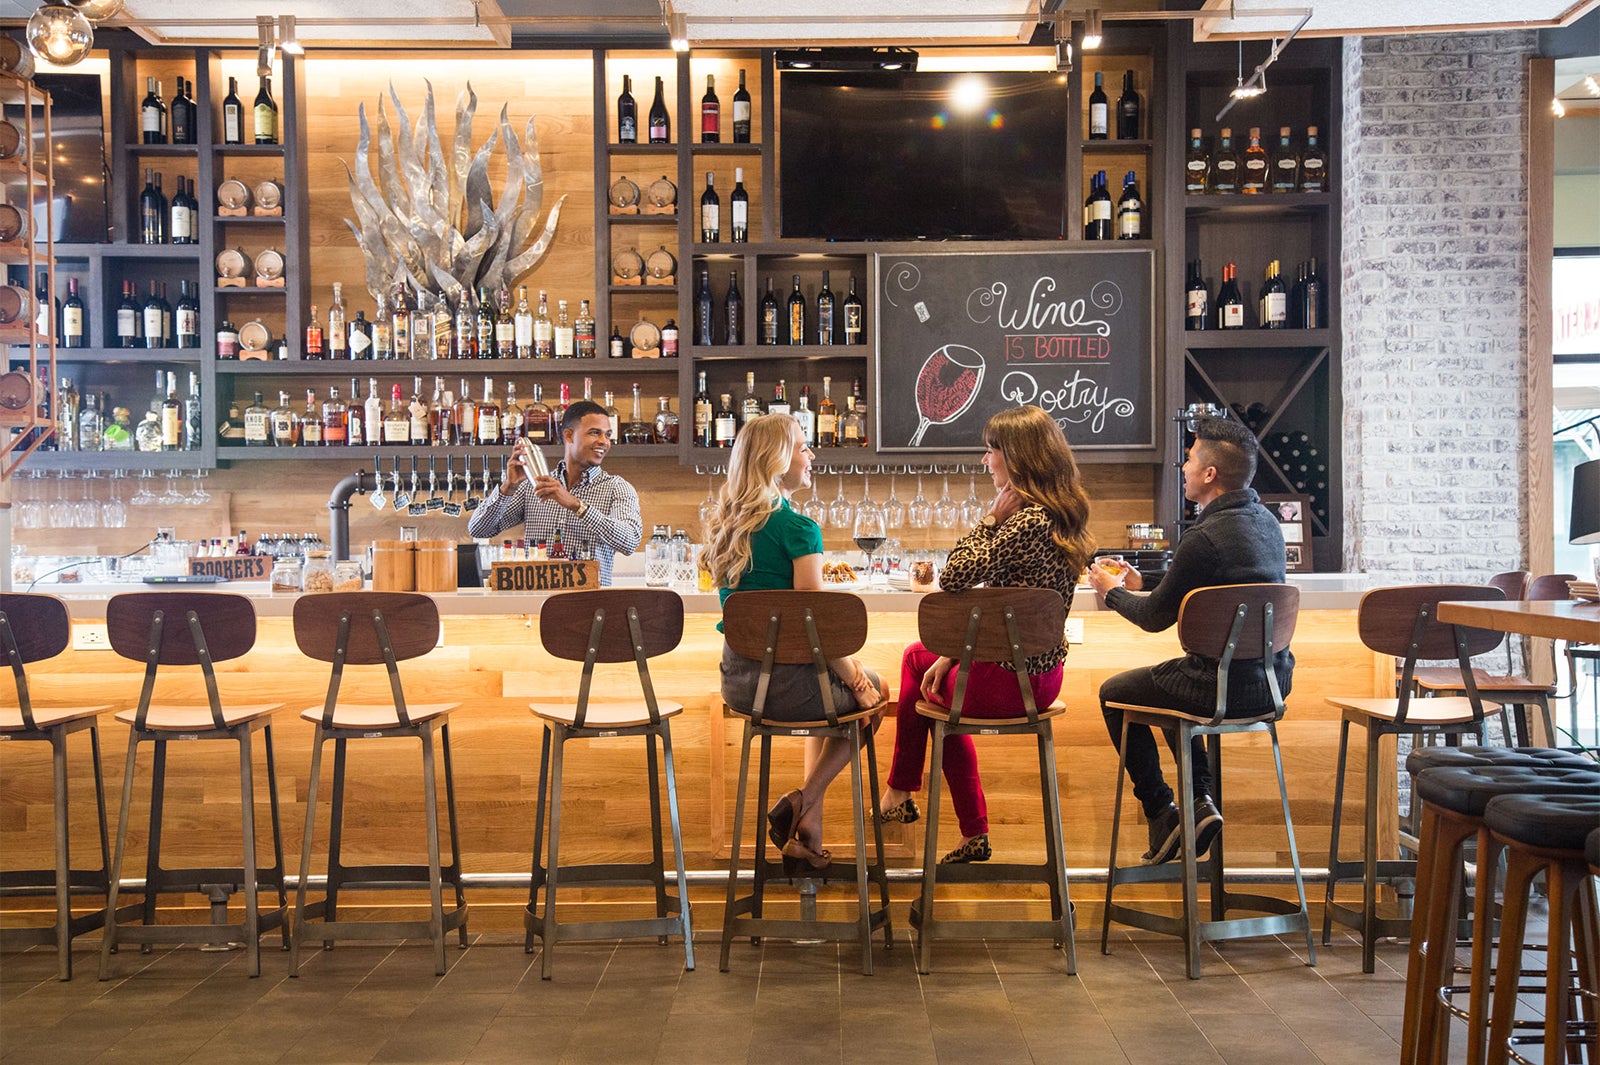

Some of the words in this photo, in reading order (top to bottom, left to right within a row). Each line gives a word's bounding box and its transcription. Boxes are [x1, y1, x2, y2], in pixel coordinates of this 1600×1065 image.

[991, 276, 1111, 337] Wine
[1005, 336, 1025, 361] IS
[1034, 336, 1110, 359] BOTTLED
[1000, 369, 1135, 434] Poetry
[191, 558, 264, 579] BOOKER'S
[496, 563, 587, 590] BOOKER'S
